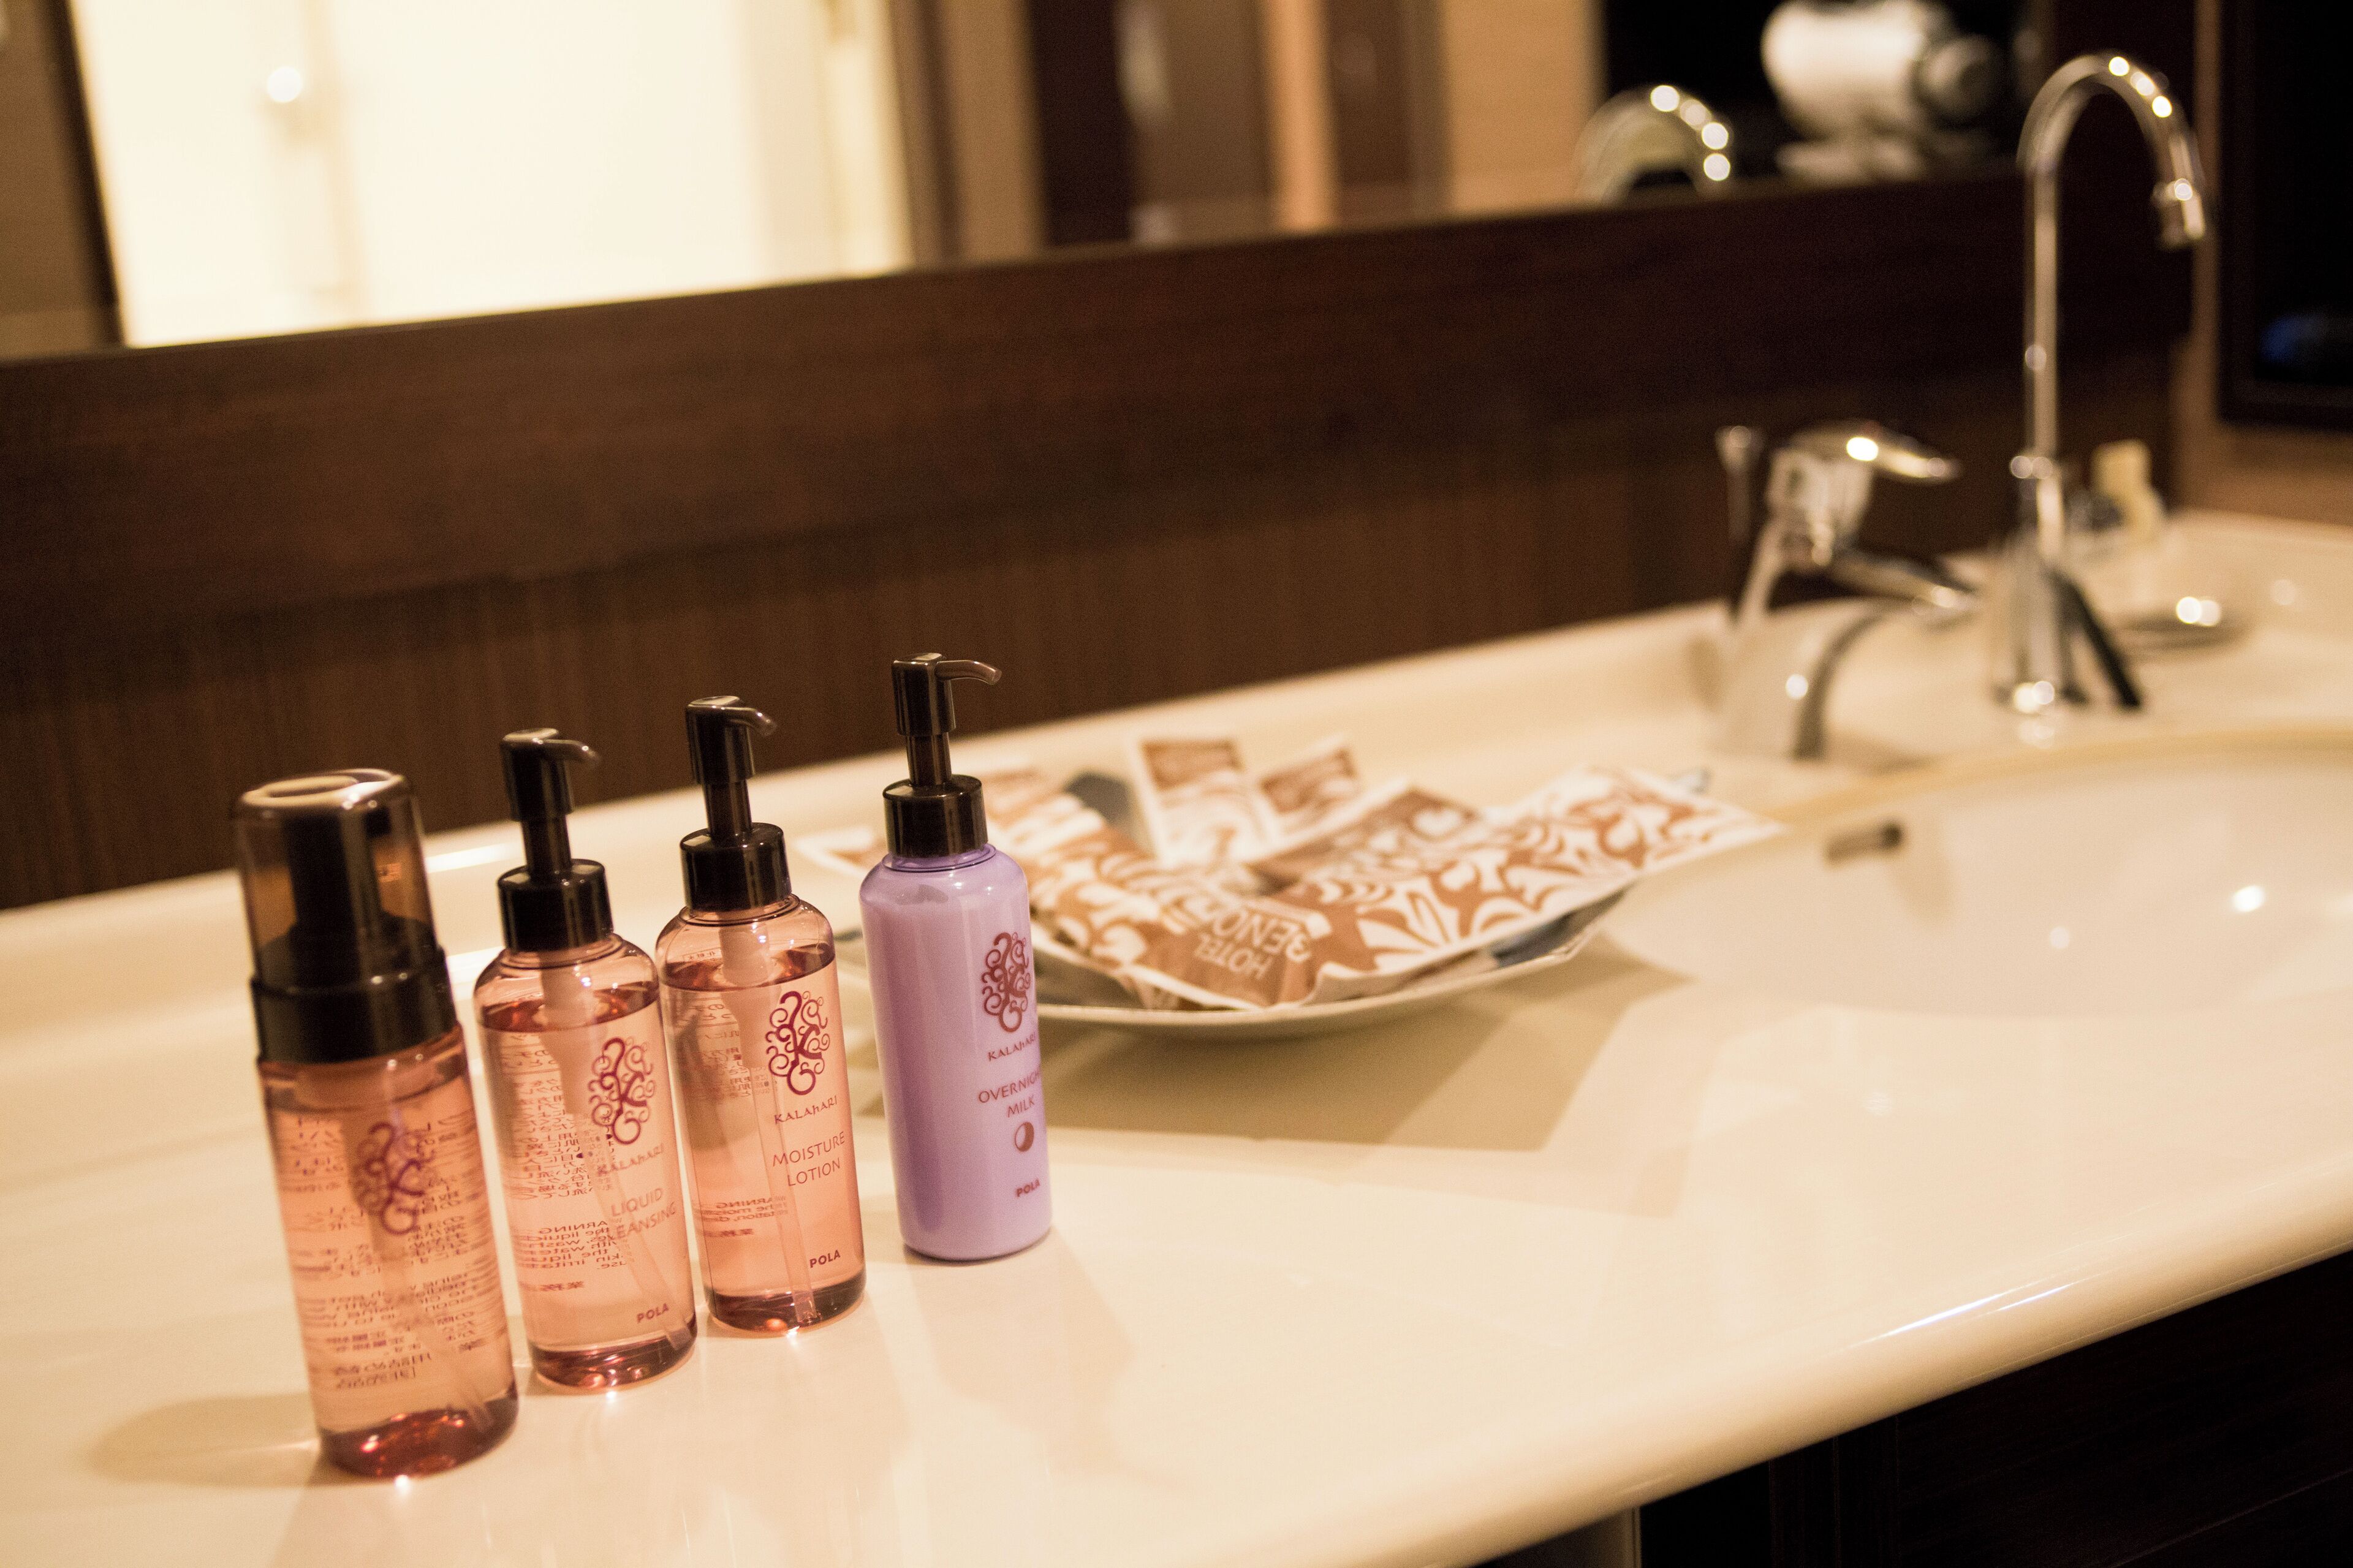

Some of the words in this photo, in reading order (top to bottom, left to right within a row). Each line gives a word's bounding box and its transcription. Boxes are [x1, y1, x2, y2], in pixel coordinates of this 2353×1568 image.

[1195, 933, 1273, 979] HOTEL
[979, 1067, 1040, 1103] OVERNIGH
[1007, 1094, 1035, 1118] MILK
[773, 1131, 845, 1167] MOISTURE
[787, 1157, 840, 1186] LOTION
[611, 1187, 663, 1217] LIQUID
[1016, 1178, 1040, 1197] POLA
[809, 1249, 841, 1268] POLA
[637, 1303, 669, 1324] POLA
